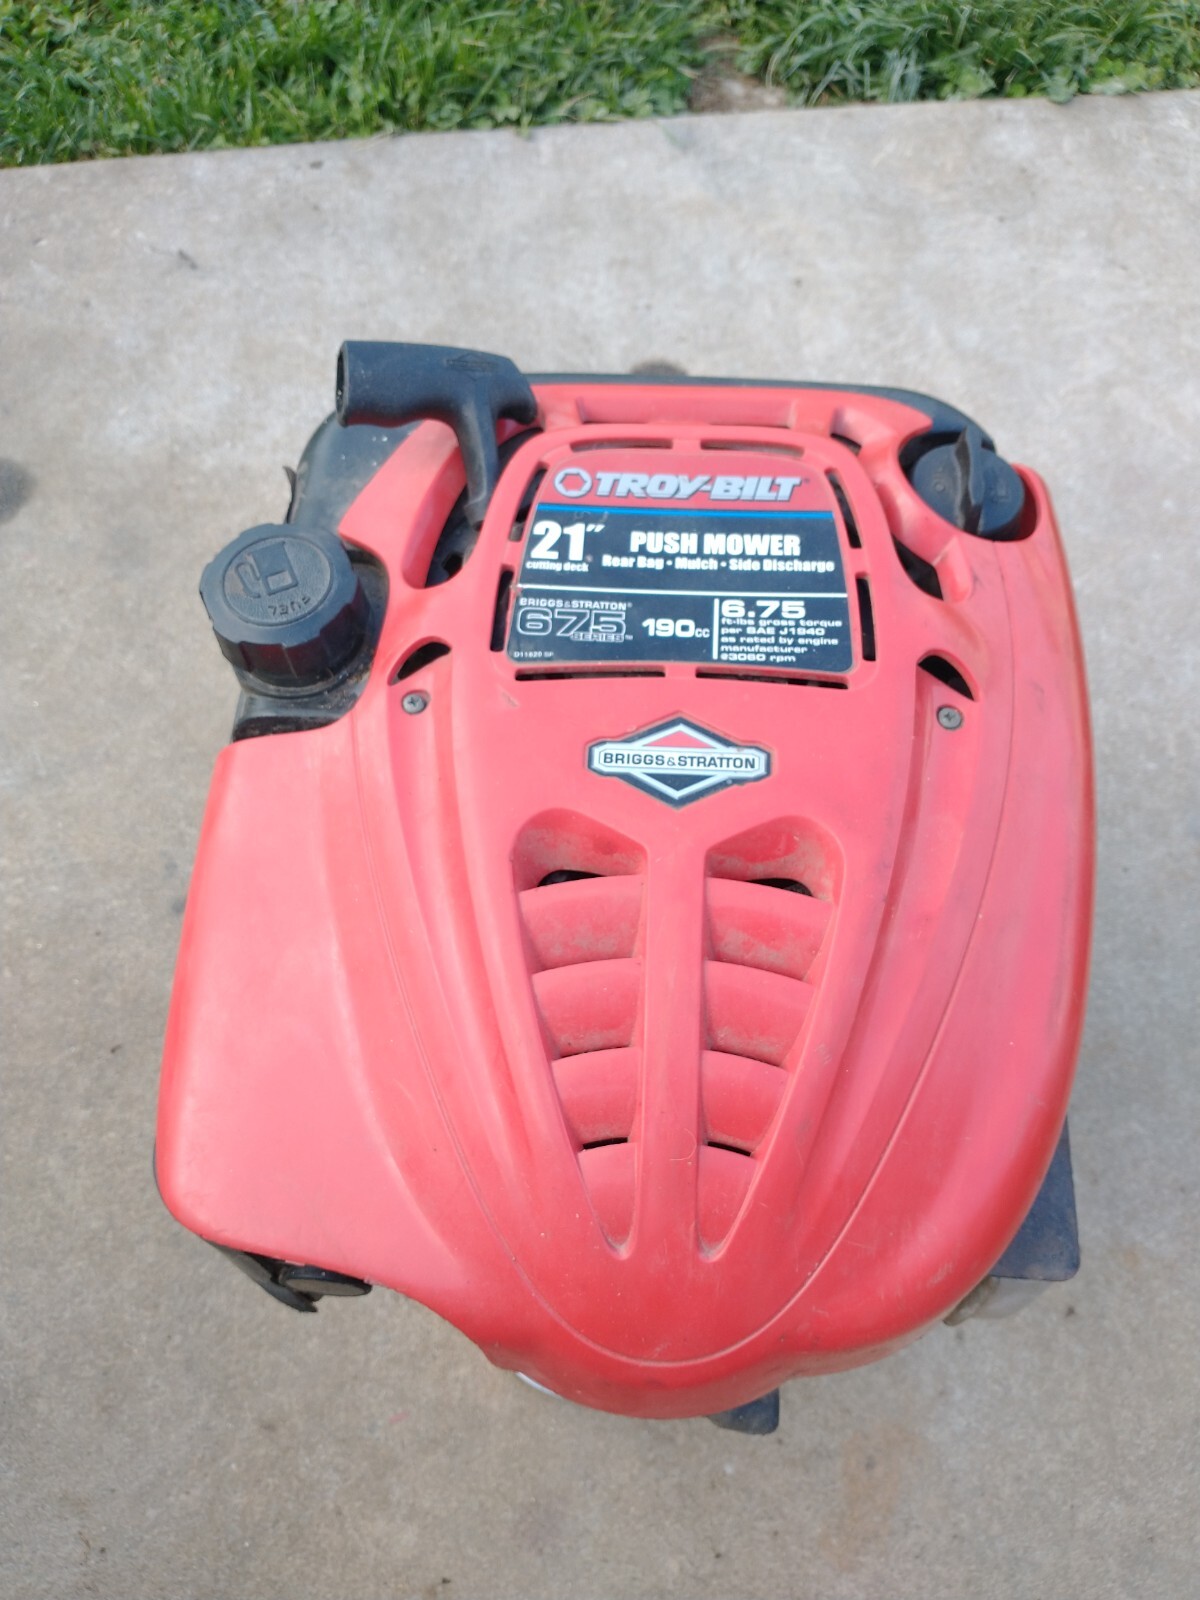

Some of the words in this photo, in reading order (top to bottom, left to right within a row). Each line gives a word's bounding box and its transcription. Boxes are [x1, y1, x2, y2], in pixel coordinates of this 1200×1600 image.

[595, 472, 802, 501] TROY-BILT
[630, 531, 698, 554] PUSH
[703, 532, 801, 556] MOWER
[525, 561, 562, 572] cutting
[563, 562, 589, 572] deck
[602, 554, 635, 567] Rear
[637, 555, 664, 570] Bag
[675, 556, 718, 570] Mulch
[729, 558, 760, 571] Side
[762, 559, 835, 573] Discharge
[721, 600, 806, 619] 6.75
[516, 606, 626, 636] 675
[758, 619, 796, 627] gross
[800, 618, 843, 628] torque
[721, 627, 742, 636] per
[746, 627, 776, 635] SAE
[720, 636, 736, 644] as
[740, 636, 776, 644] rated
[778, 636, 794, 646] by
[798, 637, 839, 646] engine
[720, 645, 808, 654] manufacturer
[770, 655, 796, 664] rpm
[603, 752, 756, 769] BRIGGS&STRATTON
